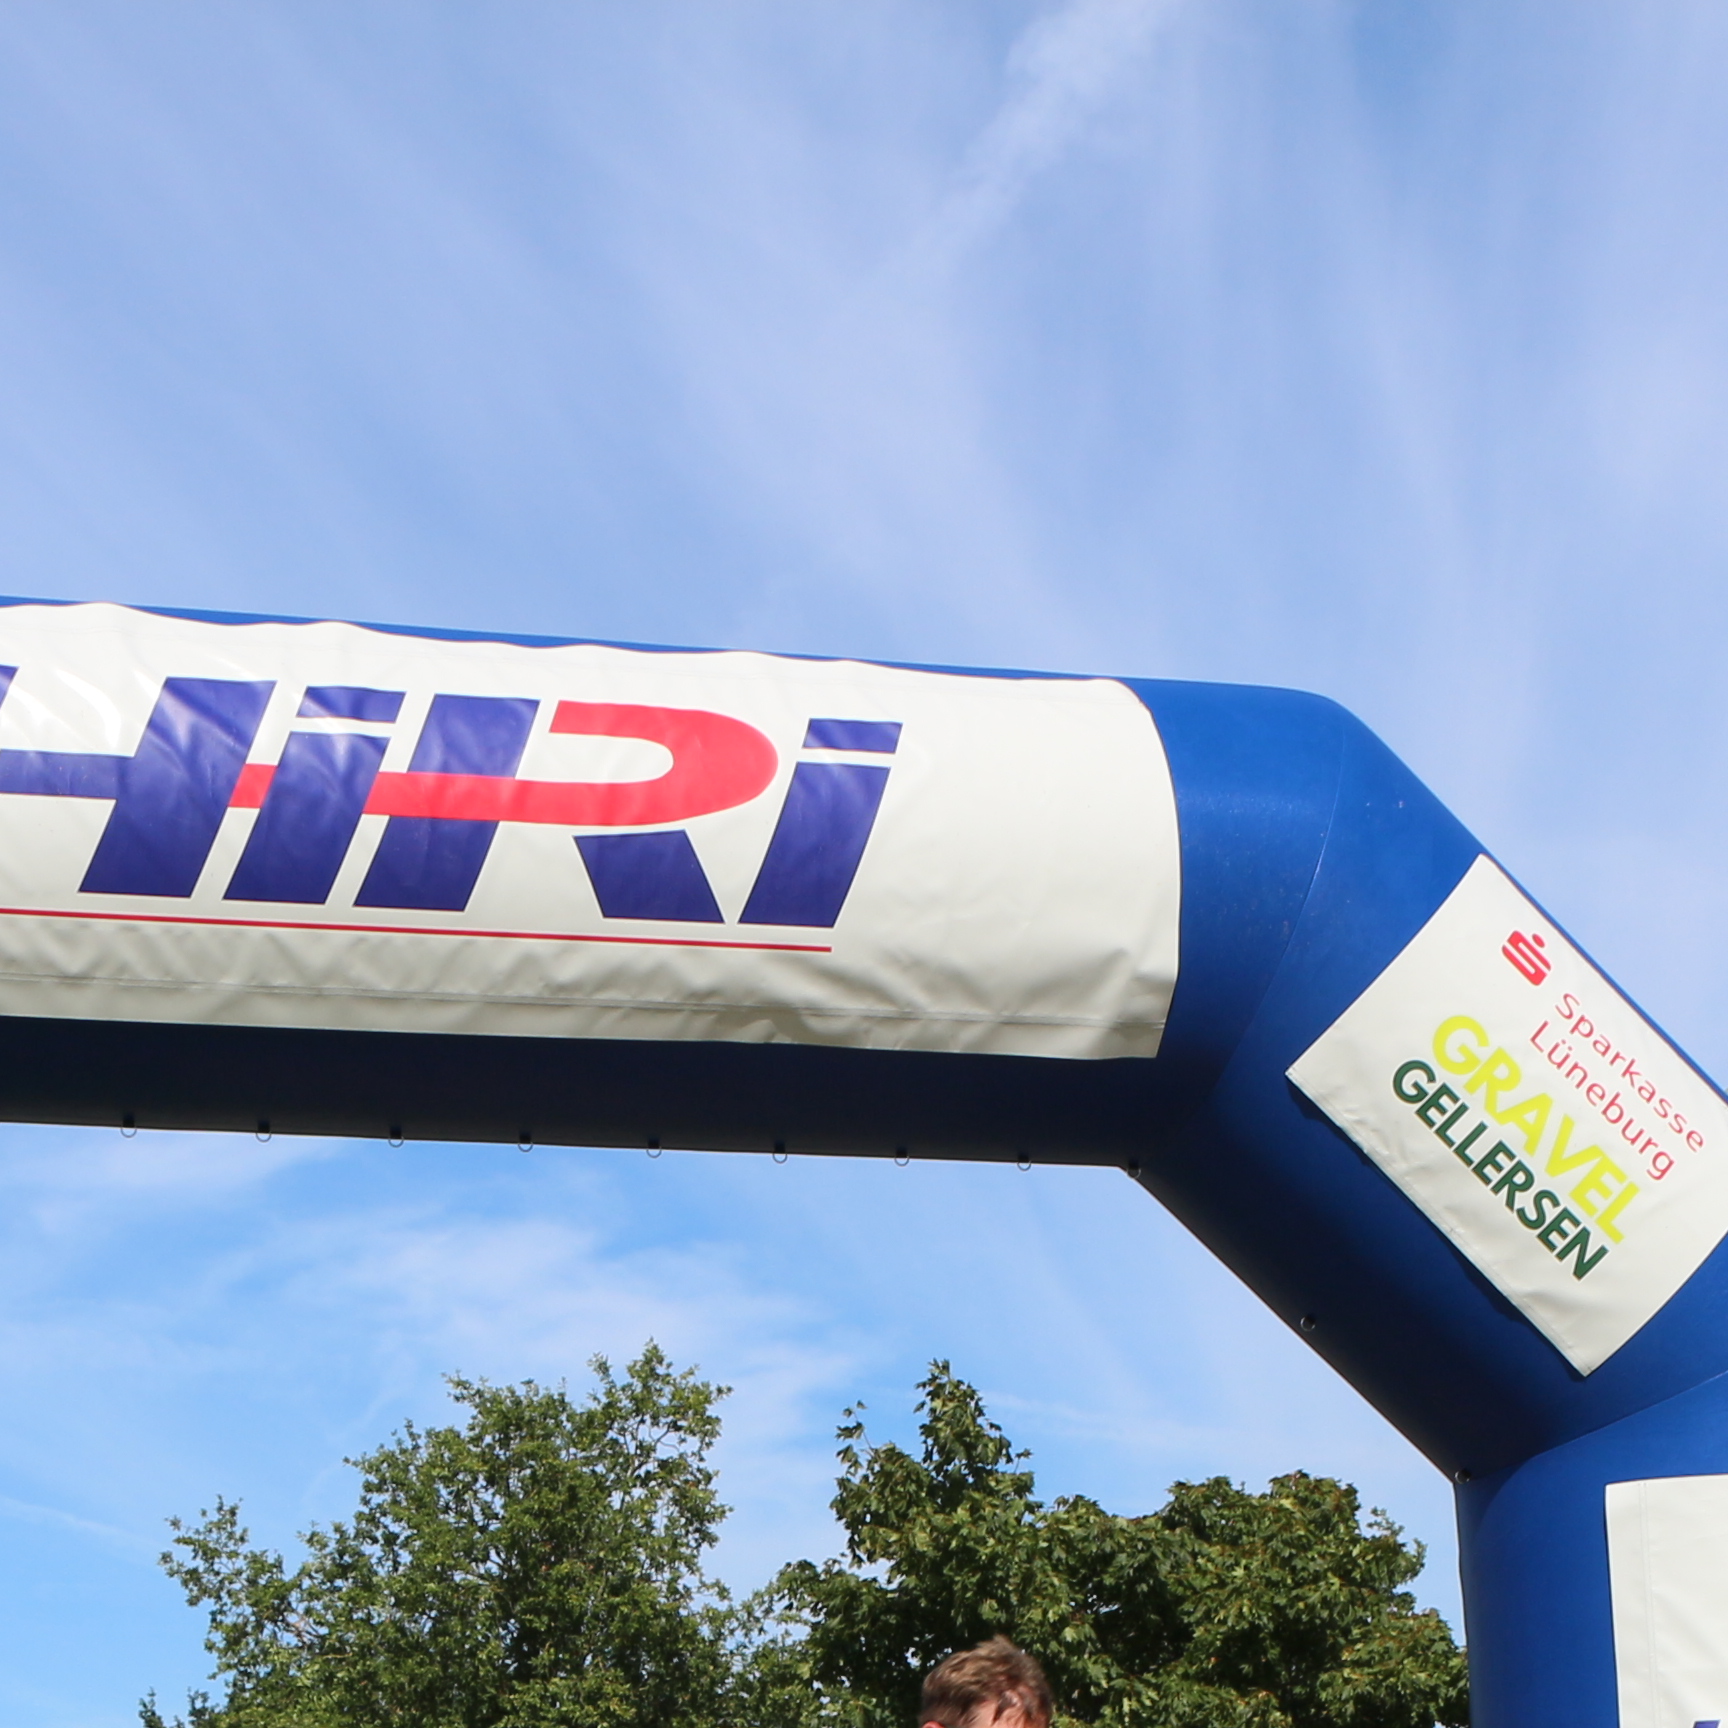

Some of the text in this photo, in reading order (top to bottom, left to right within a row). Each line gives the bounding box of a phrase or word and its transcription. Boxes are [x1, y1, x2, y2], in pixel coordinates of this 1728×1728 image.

[1432, 1015, 1640, 1244] GRAVEL
[1529, 1021, 1674, 1180] Lüneburg
[1554, 993, 1705, 1152] Sparkasse
[1392, 1060, 1609, 1280] GELLERSEN
